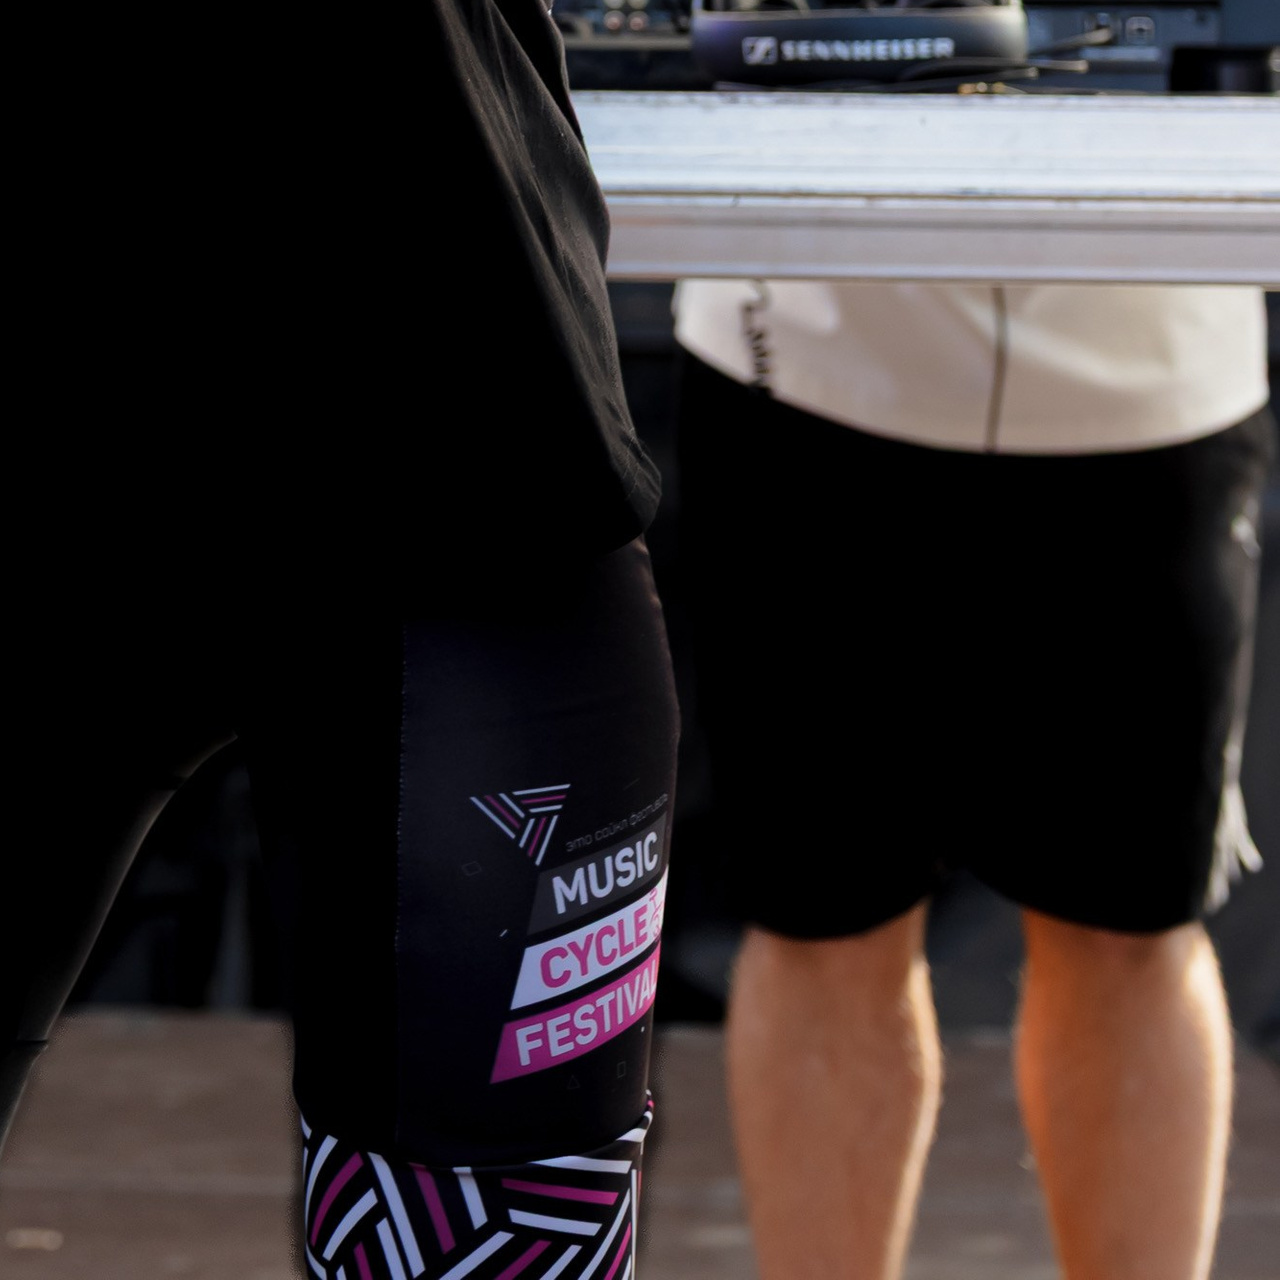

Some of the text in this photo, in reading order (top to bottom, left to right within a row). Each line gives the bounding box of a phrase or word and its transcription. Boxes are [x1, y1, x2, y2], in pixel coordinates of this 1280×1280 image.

[781, 38, 954, 61] SENNHEISER
[552, 832, 658, 914] MUSIC
[540, 905, 648, 988] CYCLE
[516, 960, 656, 1066] FESTIVAL
